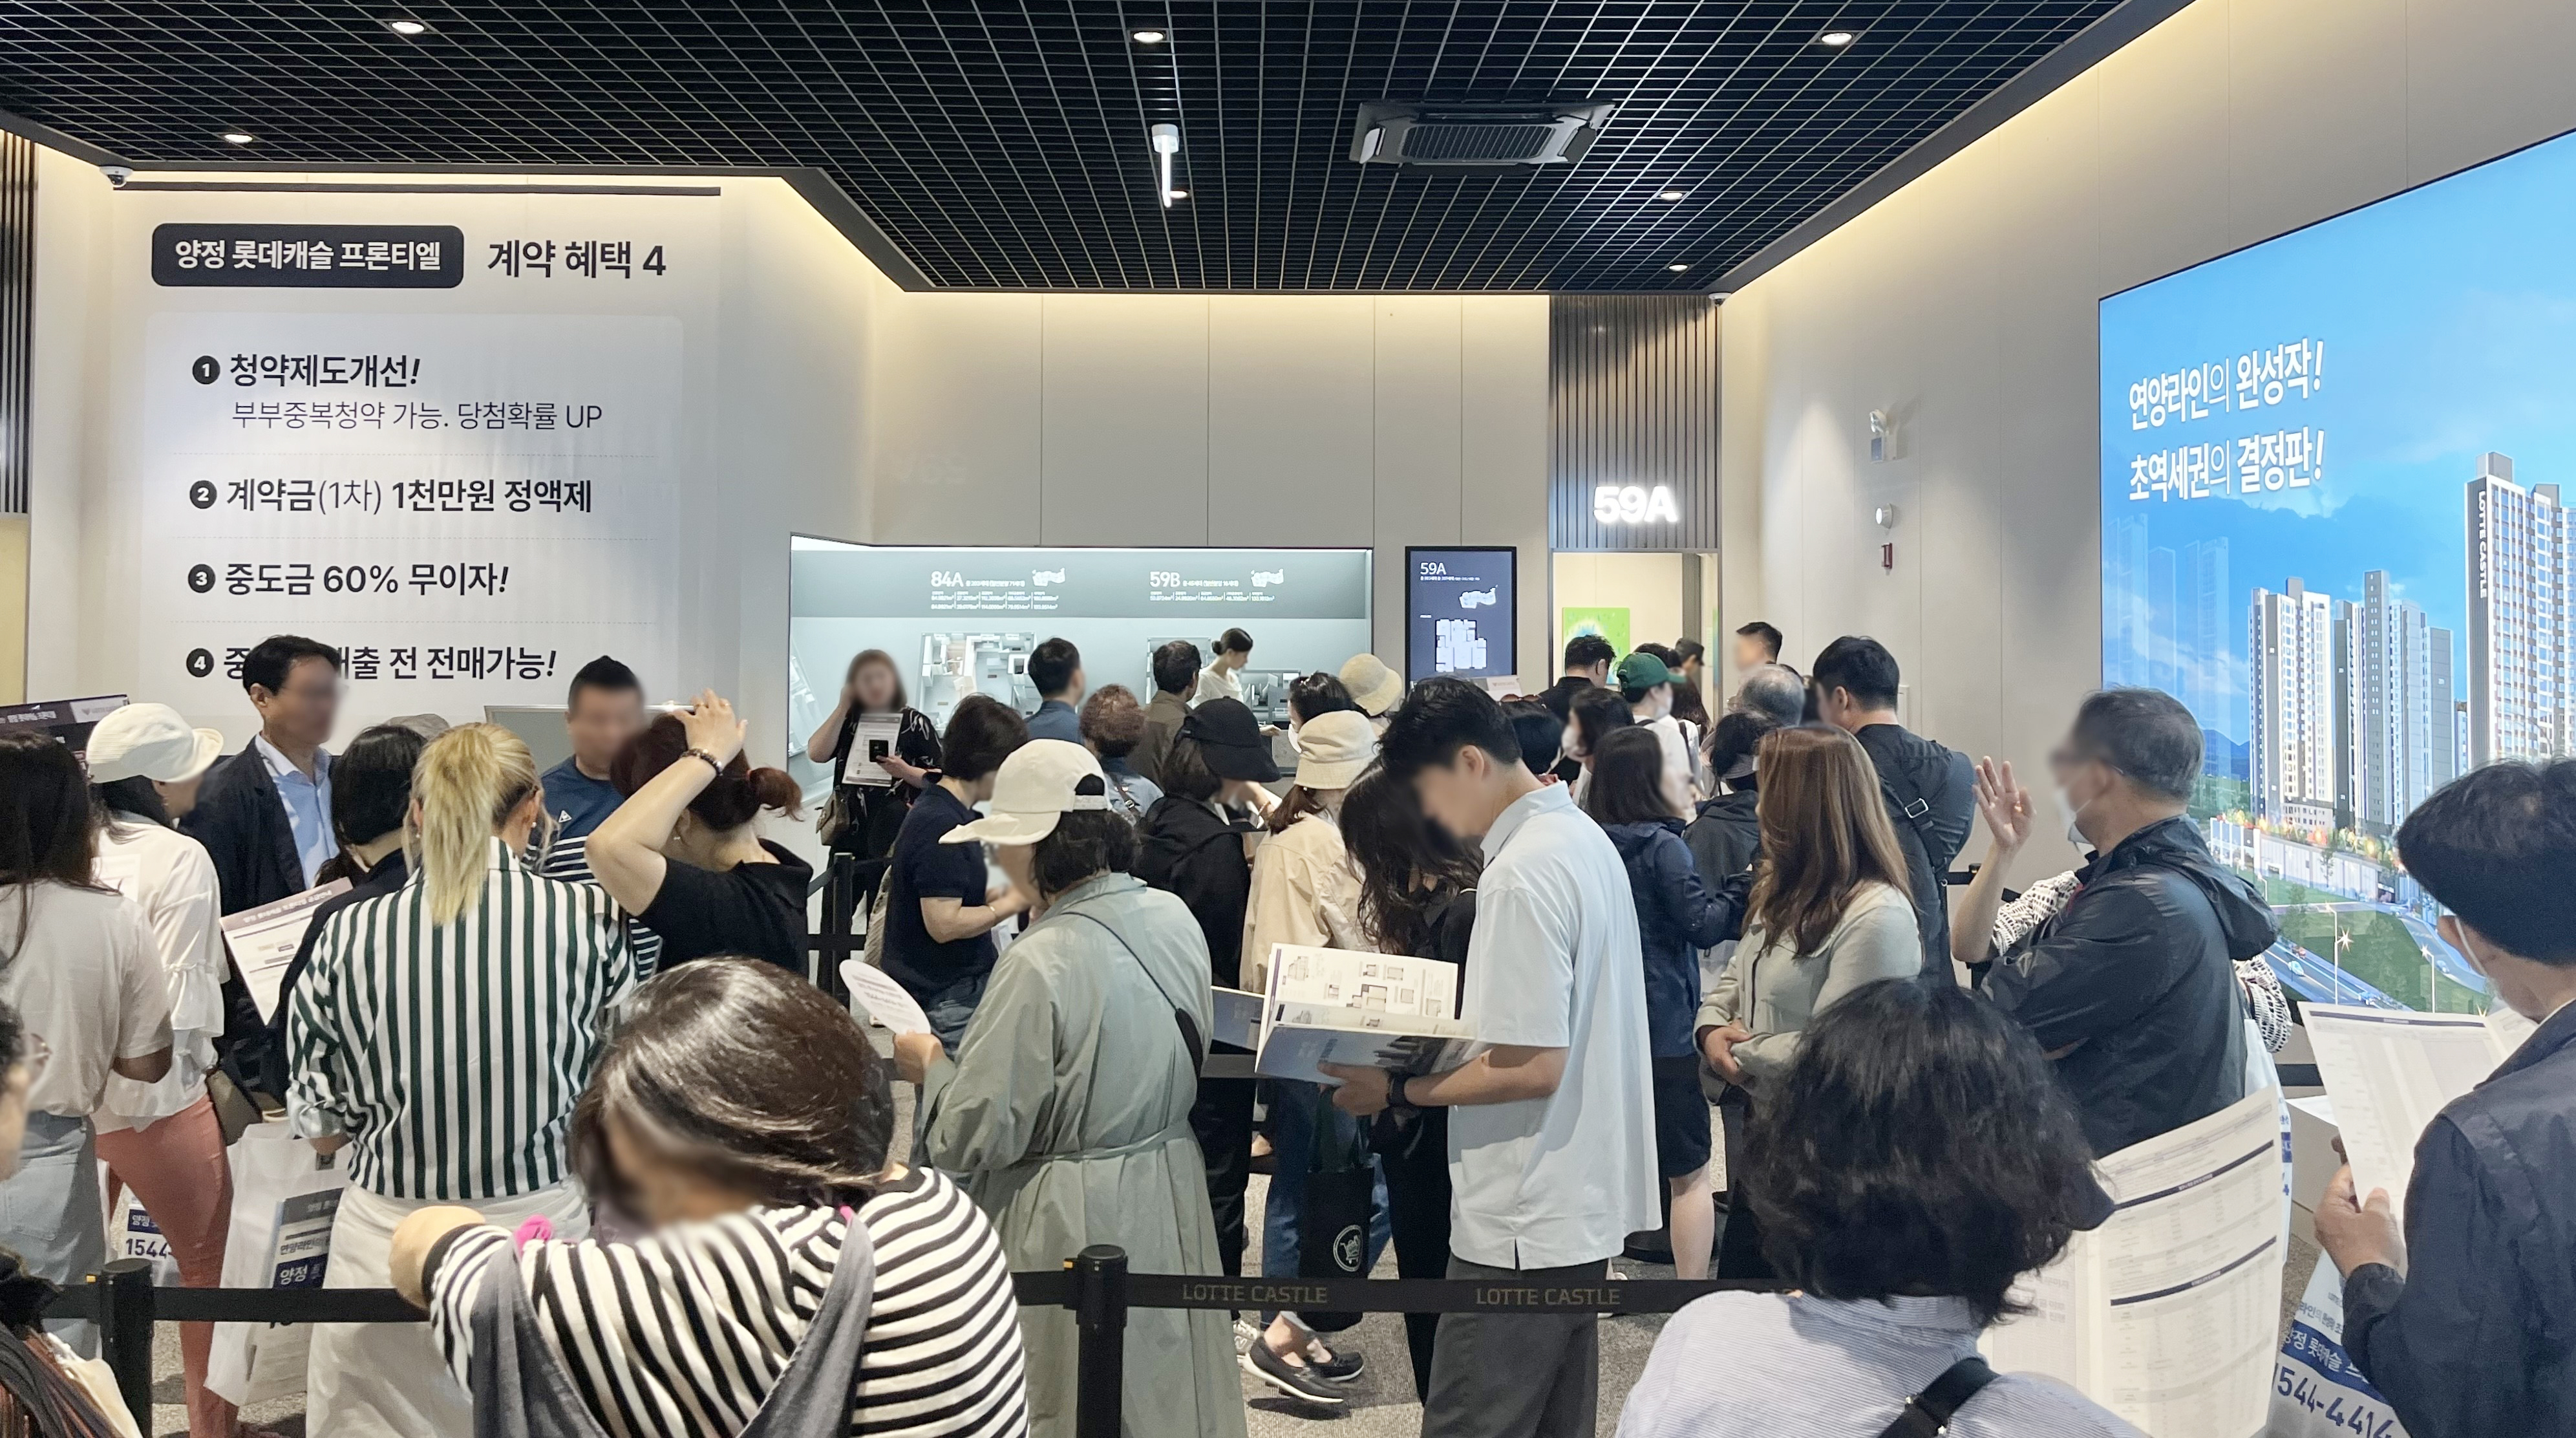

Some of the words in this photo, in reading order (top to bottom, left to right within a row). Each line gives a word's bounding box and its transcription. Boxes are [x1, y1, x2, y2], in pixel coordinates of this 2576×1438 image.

[175, 239, 225, 269] 양정
[232, 240, 334, 270] 롯데캐슬
[339, 241, 441, 270] 프론티엘
[487, 239, 556, 278] 계약
[565, 241, 631, 279] 혜택
[643, 245, 666, 276] 4
[230, 354, 420, 388] 청약제도개선!
[2129, 358, 2230, 431] 연양라인의
[2236, 338, 2324, 410] 완성작!
[232, 401, 385, 429] 부부중복청약
[393, 402, 449, 429] 가능.
[458, 402, 557, 430] 당첨확률
[566, 405, 602, 428] UP
[2129, 439, 2230, 502] 초역세권의
[2237, 426, 2325, 493] 결정판!
[227, 478, 381, 515] 계약금(1차)
[392, 479, 495, 511] 1천만원
[504, 479, 591, 513] 정액제
[1593, 486, 1678, 523] 59A
[225, 563, 315, 596] 중도금
[323, 565, 398, 594] 60%
[409, 563, 509, 596] 무이자!
[931, 570, 964, 587] 84A
[1149, 571, 1181, 588] 59B
[1420, 562, 1447, 575] 59A
[2479, 541, 2487, 599] CASTLE
[389, 647, 417, 680] 전
[427, 646, 557, 680] 전매가능!
[280, 1263, 308, 1285] 양정
[1182, 1283, 1245, 1302] LOTTE
[1251, 1285, 1328, 1304] CASTLE
[1476, 1287, 1538, 1305] LOTTE
[1544, 1288, 1621, 1305] CASTLE
